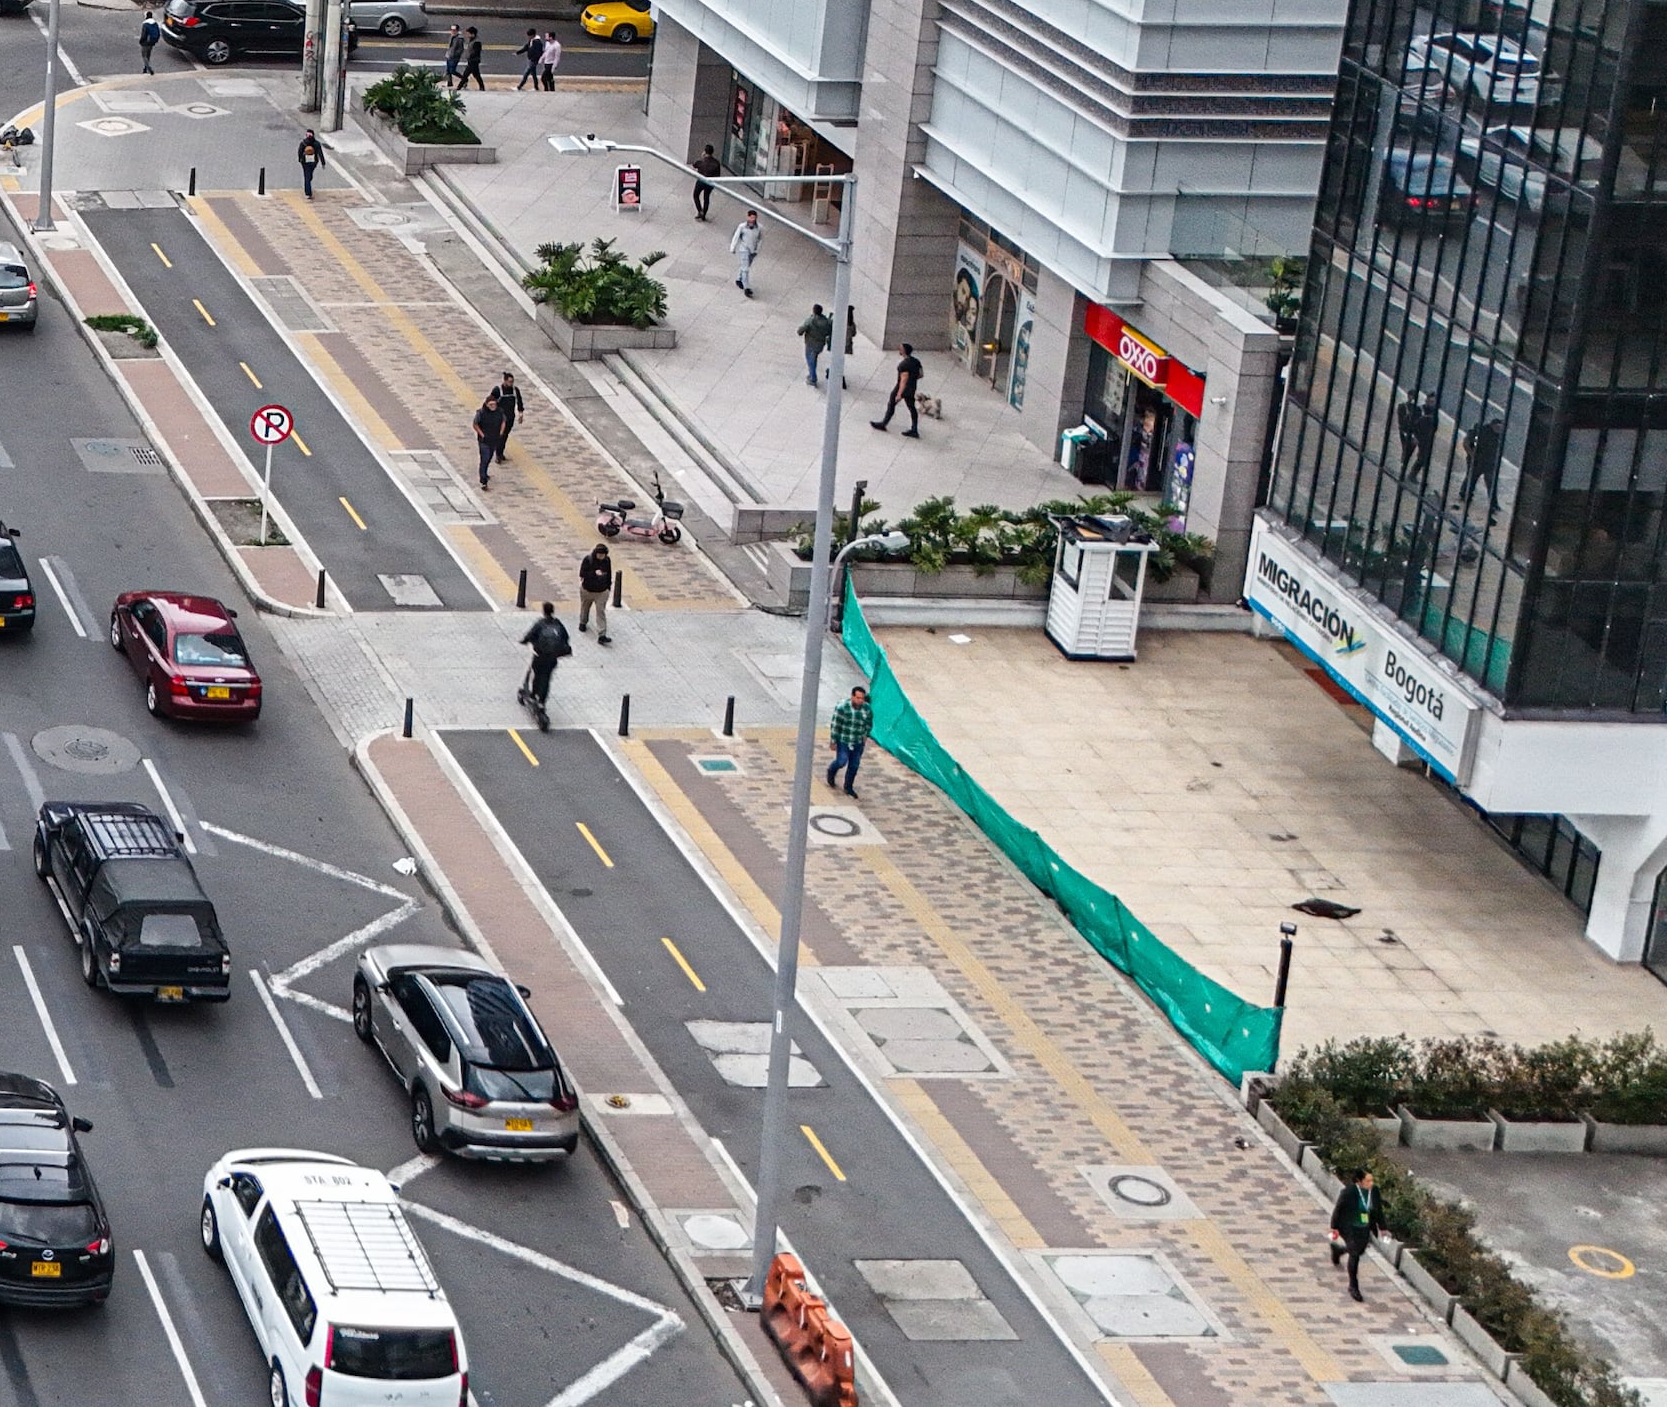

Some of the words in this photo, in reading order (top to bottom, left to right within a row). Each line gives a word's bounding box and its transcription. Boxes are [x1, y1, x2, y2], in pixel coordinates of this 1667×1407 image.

[1120, 336, 1157, 379] OXXO
[264, 412, 285, 438] P
[1259, 552, 1354, 650] MIGRACIÓN
[1385, 650, 1443, 721] Bogotá
